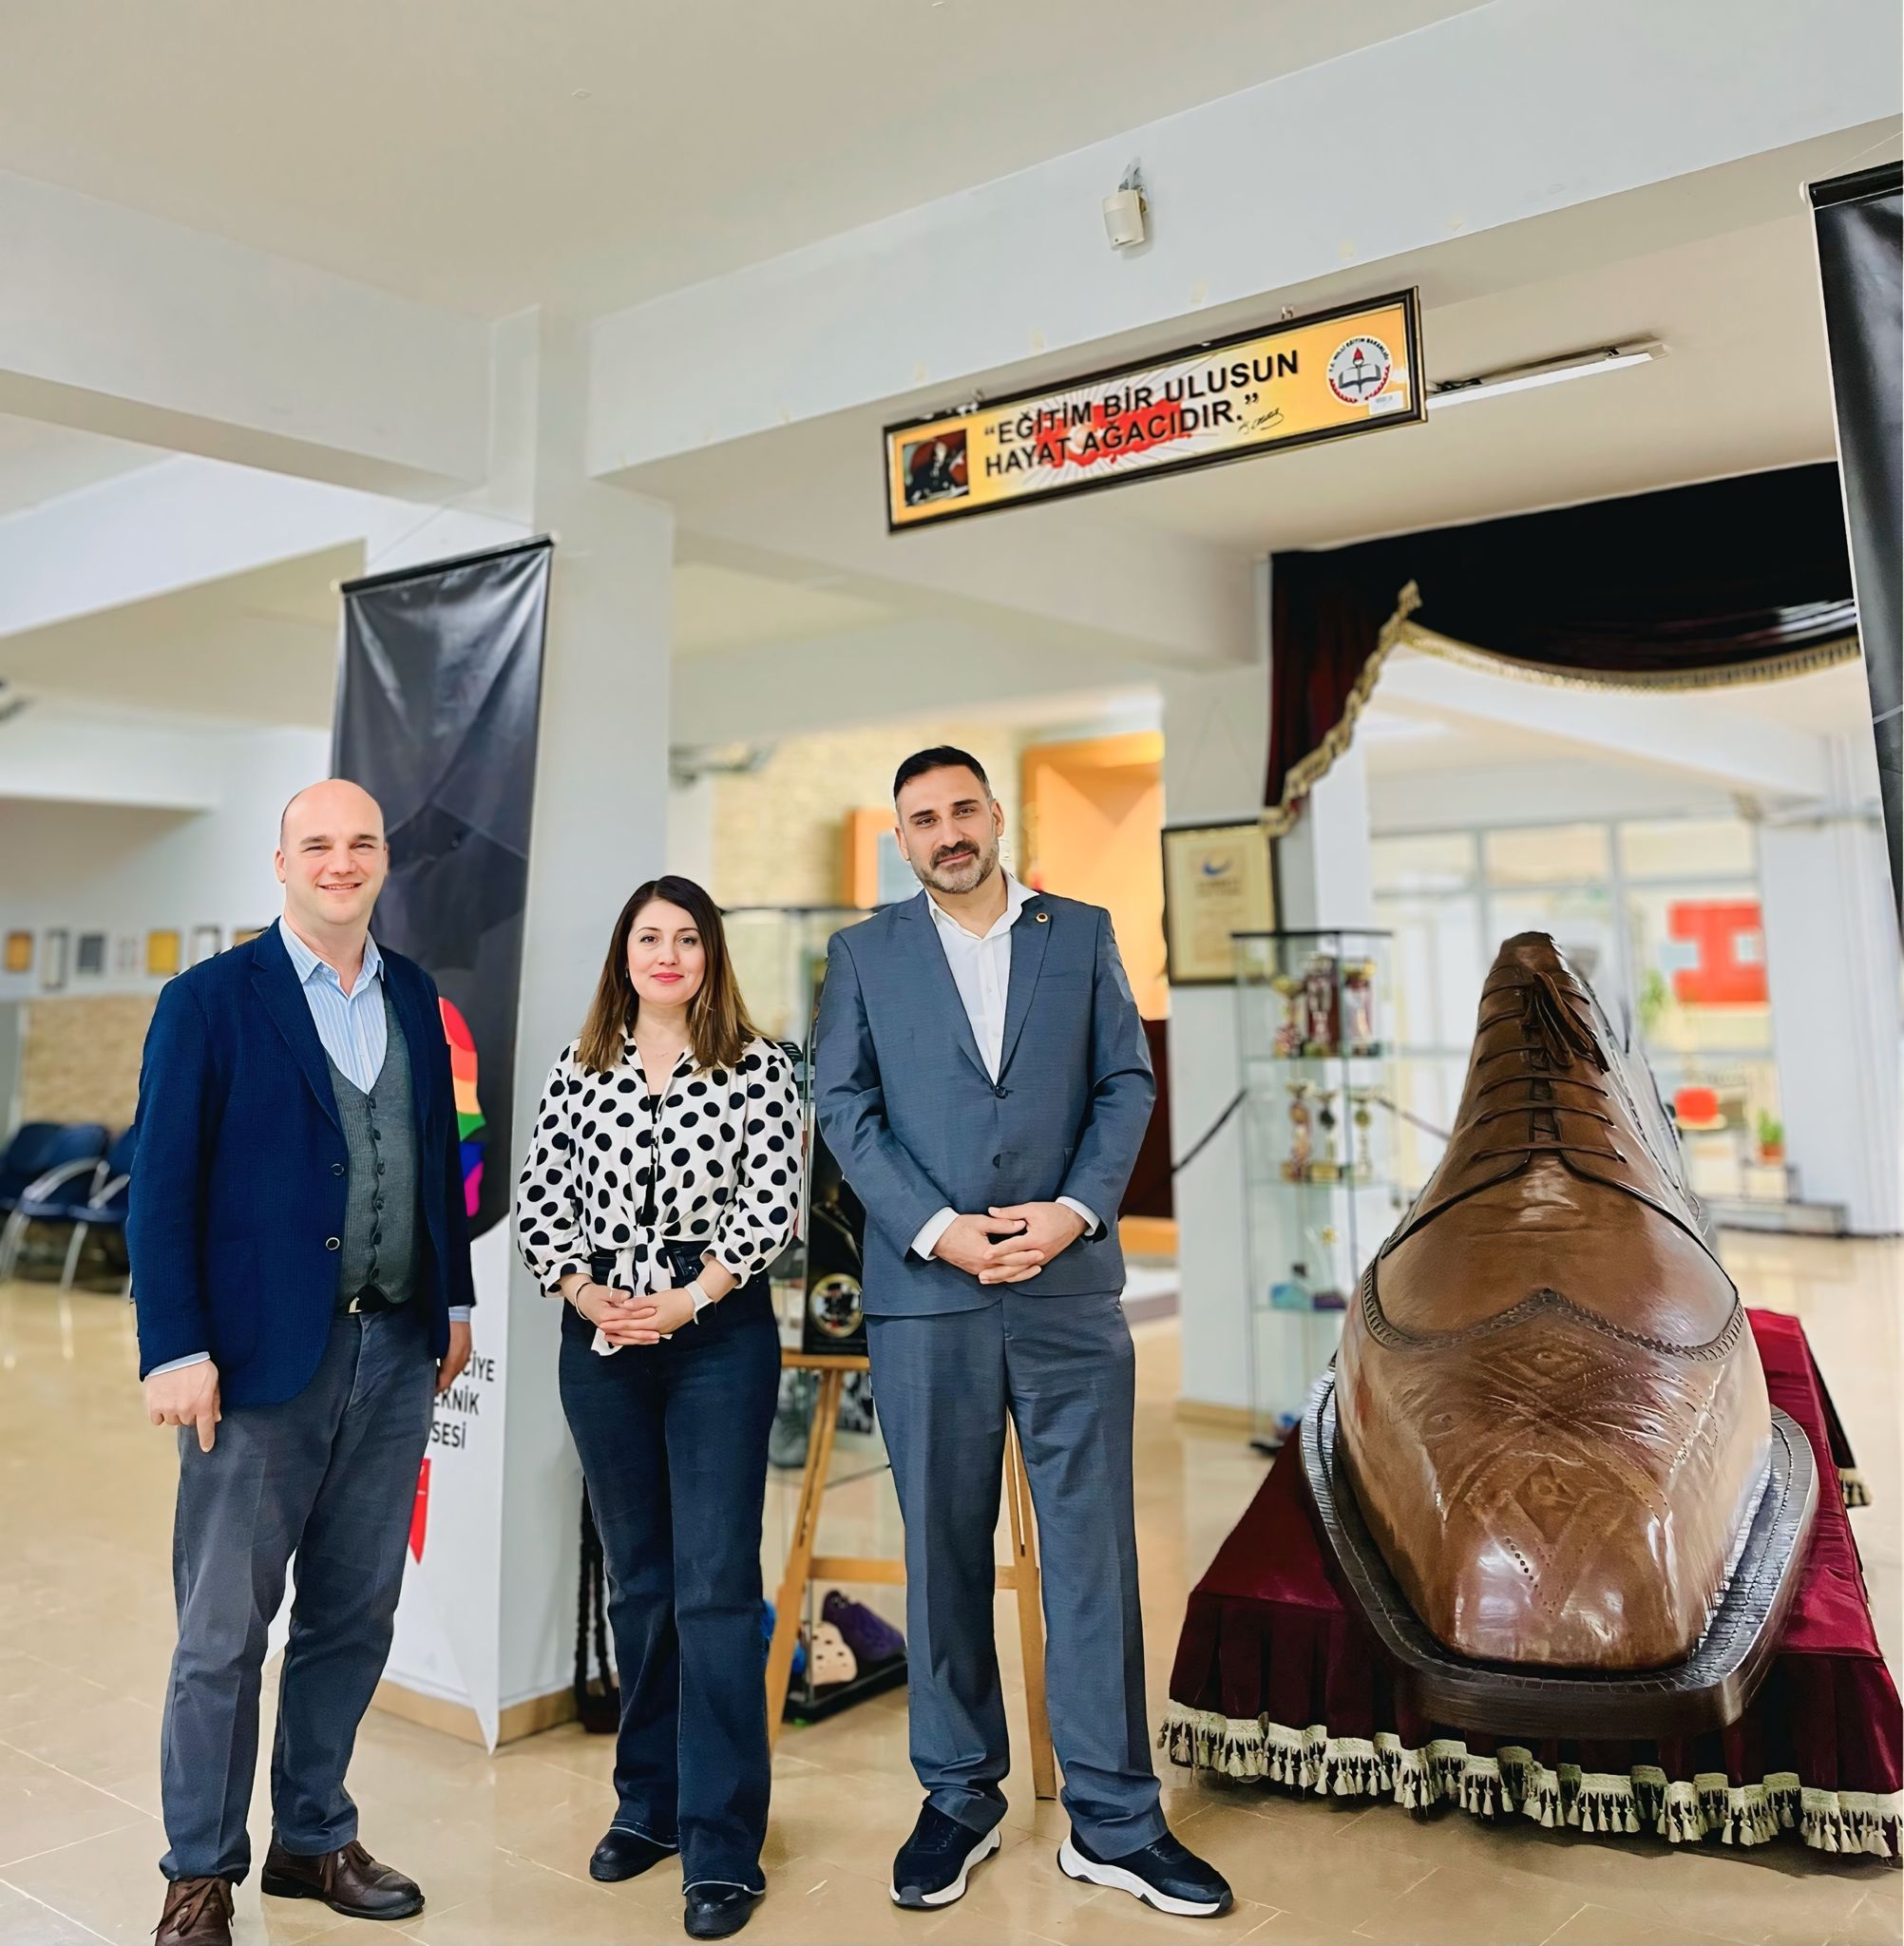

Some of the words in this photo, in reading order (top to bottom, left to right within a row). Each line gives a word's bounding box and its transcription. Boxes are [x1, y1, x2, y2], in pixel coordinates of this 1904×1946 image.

[1103, 385, 1152, 419] BİR
[1165, 349, 1299, 404] ULUSUN
[985, 436, 1072, 477] HAYAT
